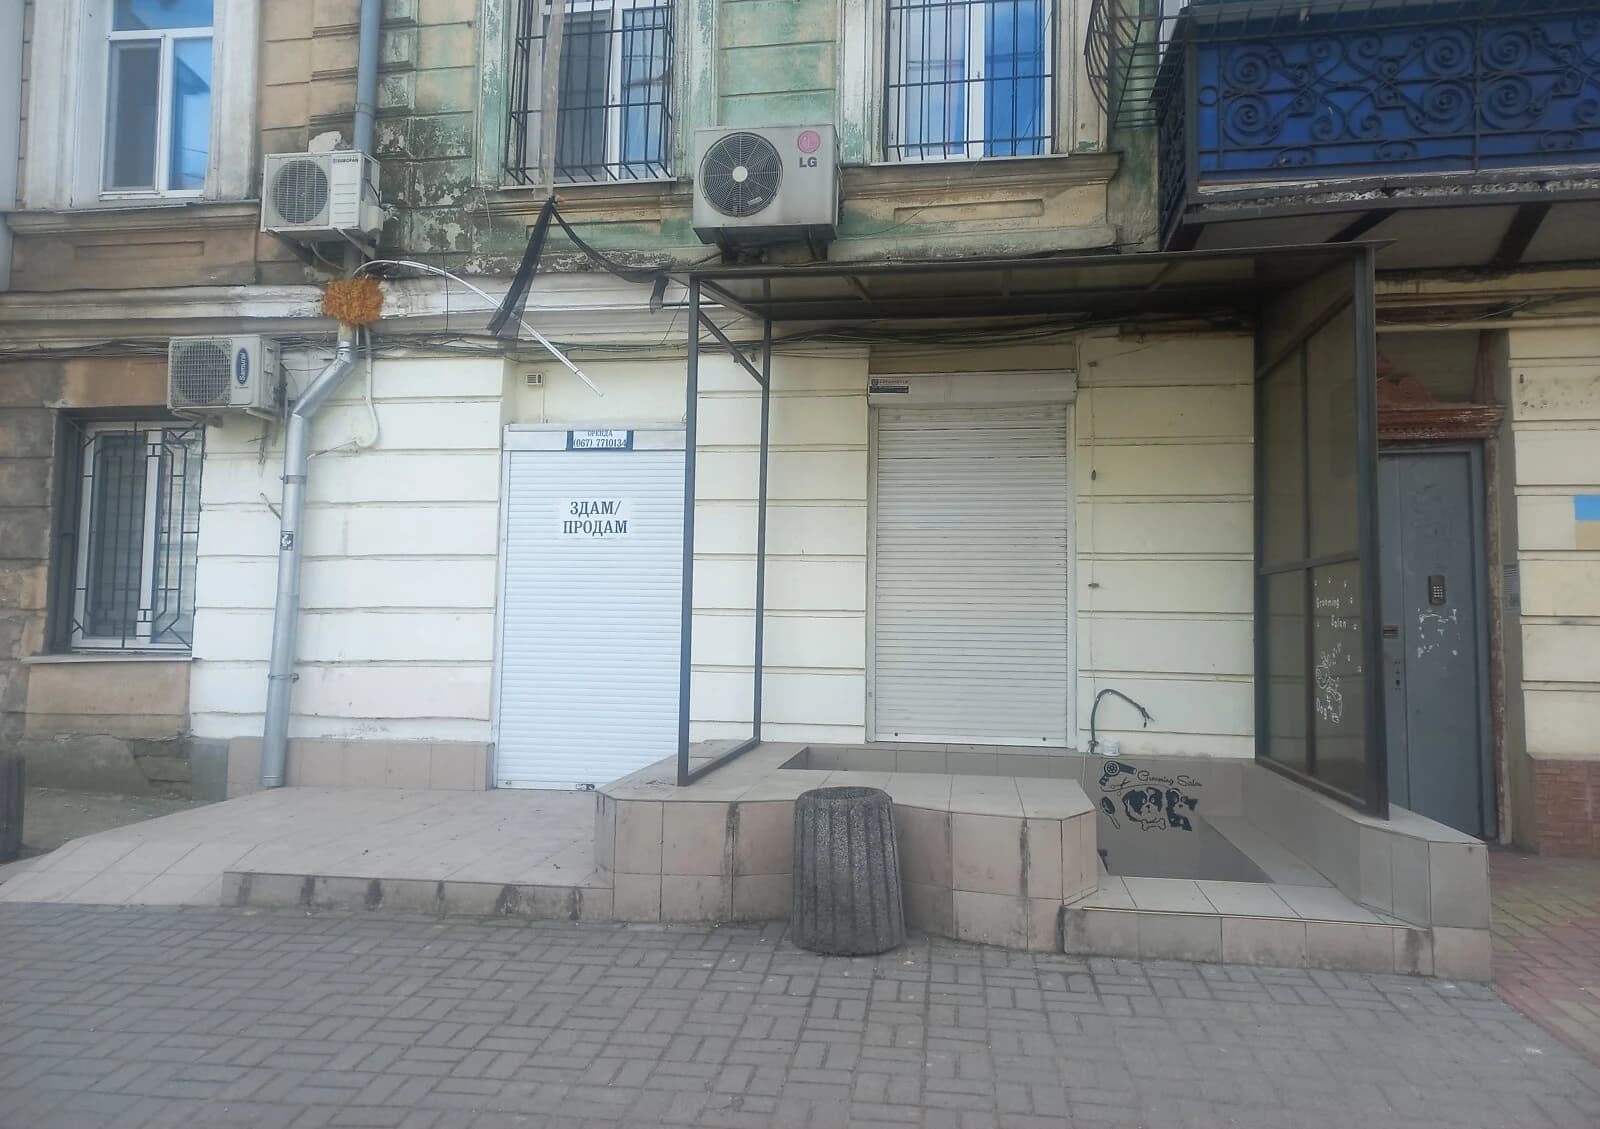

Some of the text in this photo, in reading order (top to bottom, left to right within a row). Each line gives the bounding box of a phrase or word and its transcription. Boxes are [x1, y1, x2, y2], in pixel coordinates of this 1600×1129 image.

[799, 156, 817, 168] LG
[239, 352, 247, 382] Samurai
[573, 438, 593, 448] (067)
[570, 500, 622, 518] ЗДАМ/
[563, 519, 629, 537] ПРОДАМ
[1137, 770, 1174, 785] Grooming
